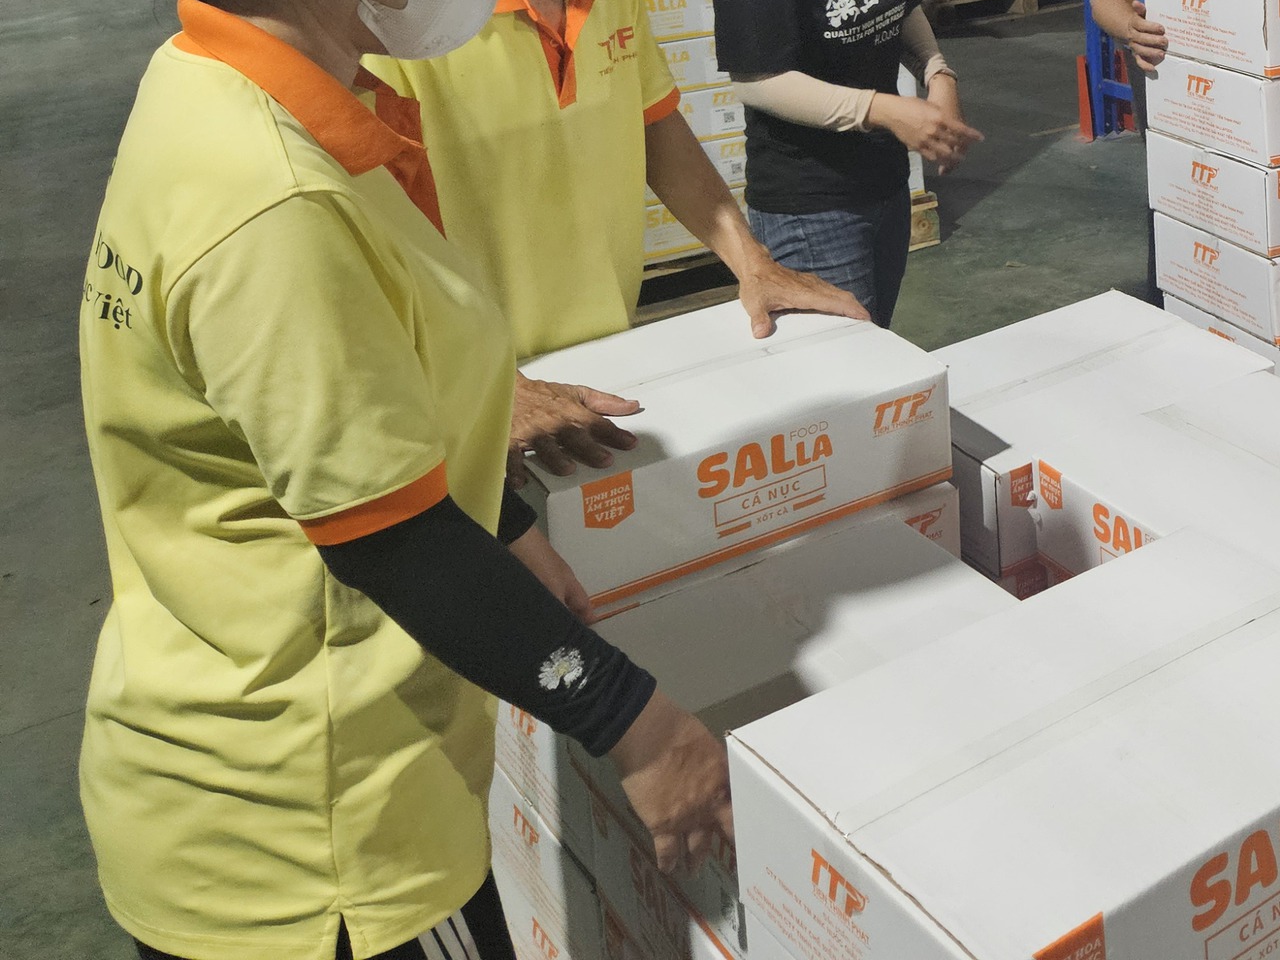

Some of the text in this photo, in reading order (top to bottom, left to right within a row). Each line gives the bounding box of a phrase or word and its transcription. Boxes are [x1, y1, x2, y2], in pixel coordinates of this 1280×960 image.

[824, 26, 860, 39] QUALITY
[1187, 74, 1214, 95] TTP
[1191, 161, 1218, 183] TTP
[1194, 241, 1220, 265] TTP
[874, 388, 932, 430] TTP
[789, 420, 829, 442] FOOD
[697, 434, 833, 499] SALLA
[741, 480, 800, 510] CÁ NỤC
[811, 848, 866, 918] TTP
[1239, 910, 1264, 942] CÁ
